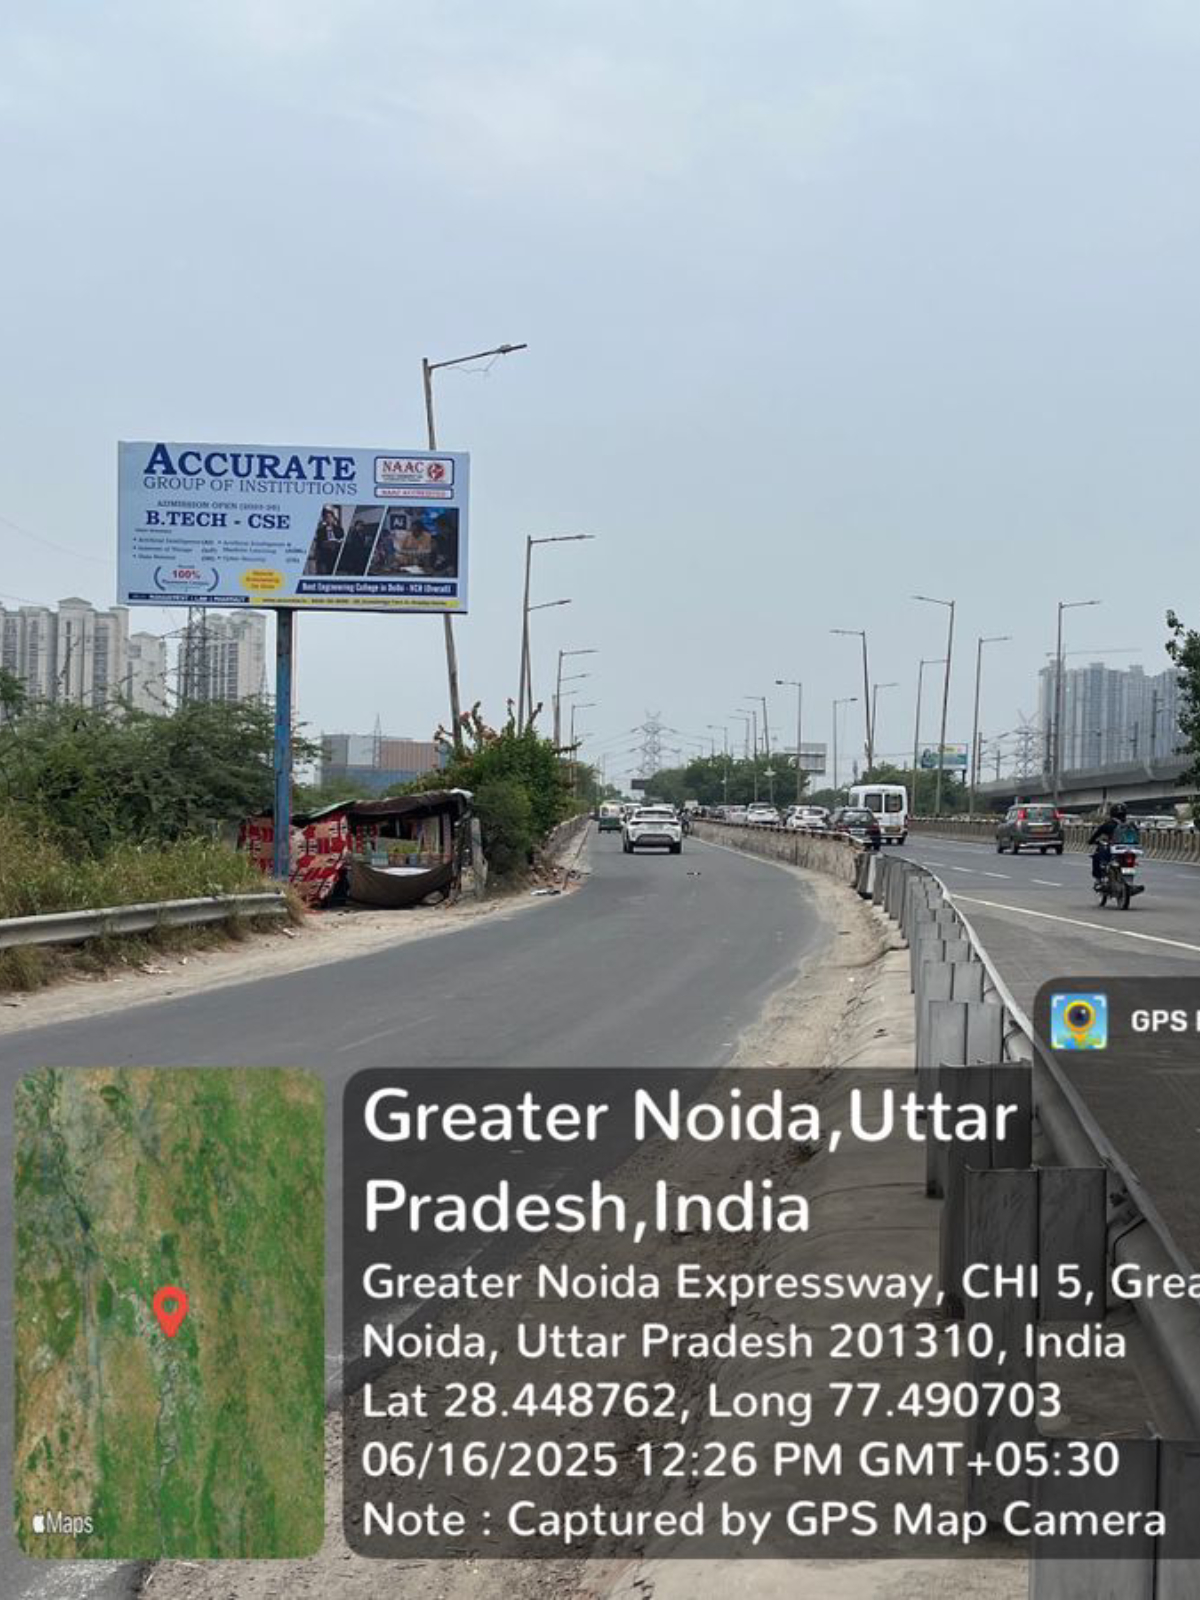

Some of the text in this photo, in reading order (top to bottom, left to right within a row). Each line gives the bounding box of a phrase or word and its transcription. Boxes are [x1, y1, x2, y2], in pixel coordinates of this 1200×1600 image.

[143, 443, 357, 481] ACCURATE
[382, 461, 425, 474] NAAC
[143, 476, 357, 496] GROUP OF INSTITUTIONS
[157, 500, 210, 509] ADMISSION
[211, 502, 238, 510] OPEN
[146, 510, 228, 527] B.TECH
[247, 513, 290, 530] CSE
[172, 570, 201, 580] 100%
[317, 583, 355, 593] Engineering
[355, 583, 379, 593] College
